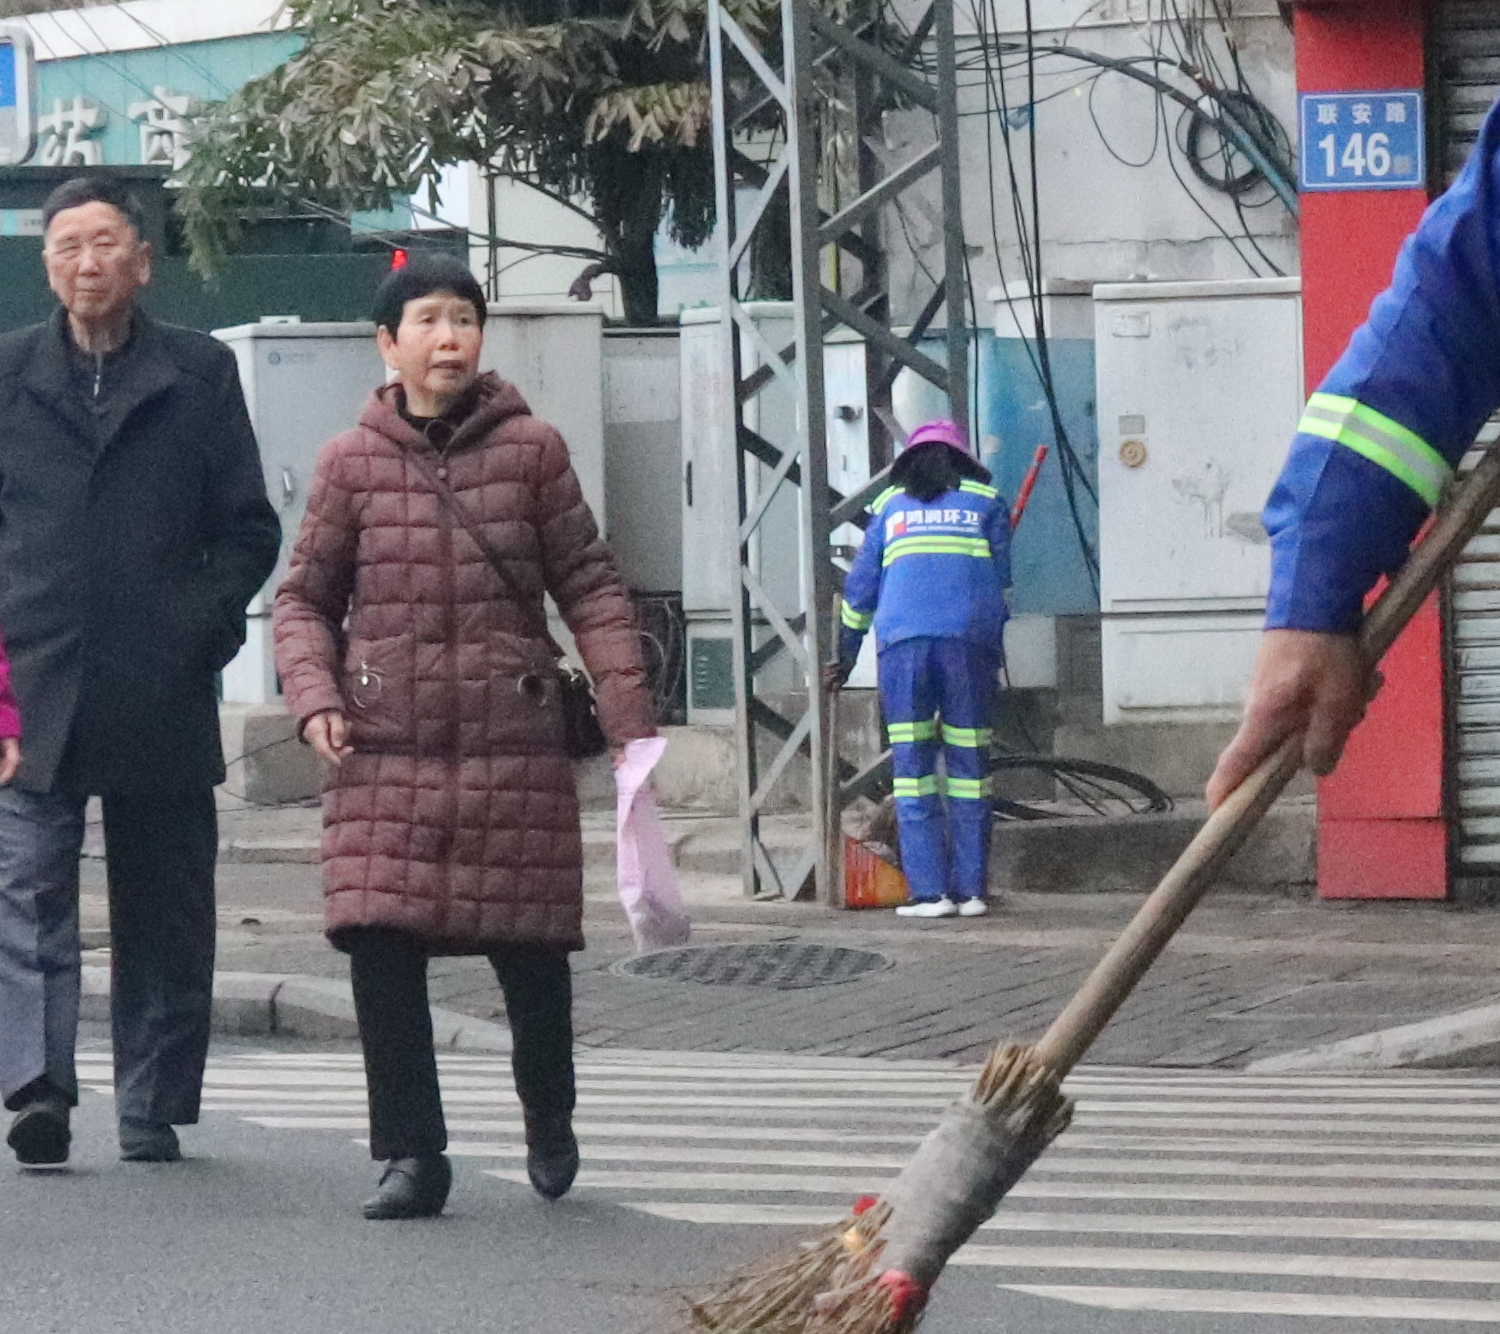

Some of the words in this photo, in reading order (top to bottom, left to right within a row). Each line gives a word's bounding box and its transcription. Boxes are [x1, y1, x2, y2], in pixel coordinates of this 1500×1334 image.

[1316, 101, 1407, 125] 联安路
[1318, 132, 1391, 177] 146
